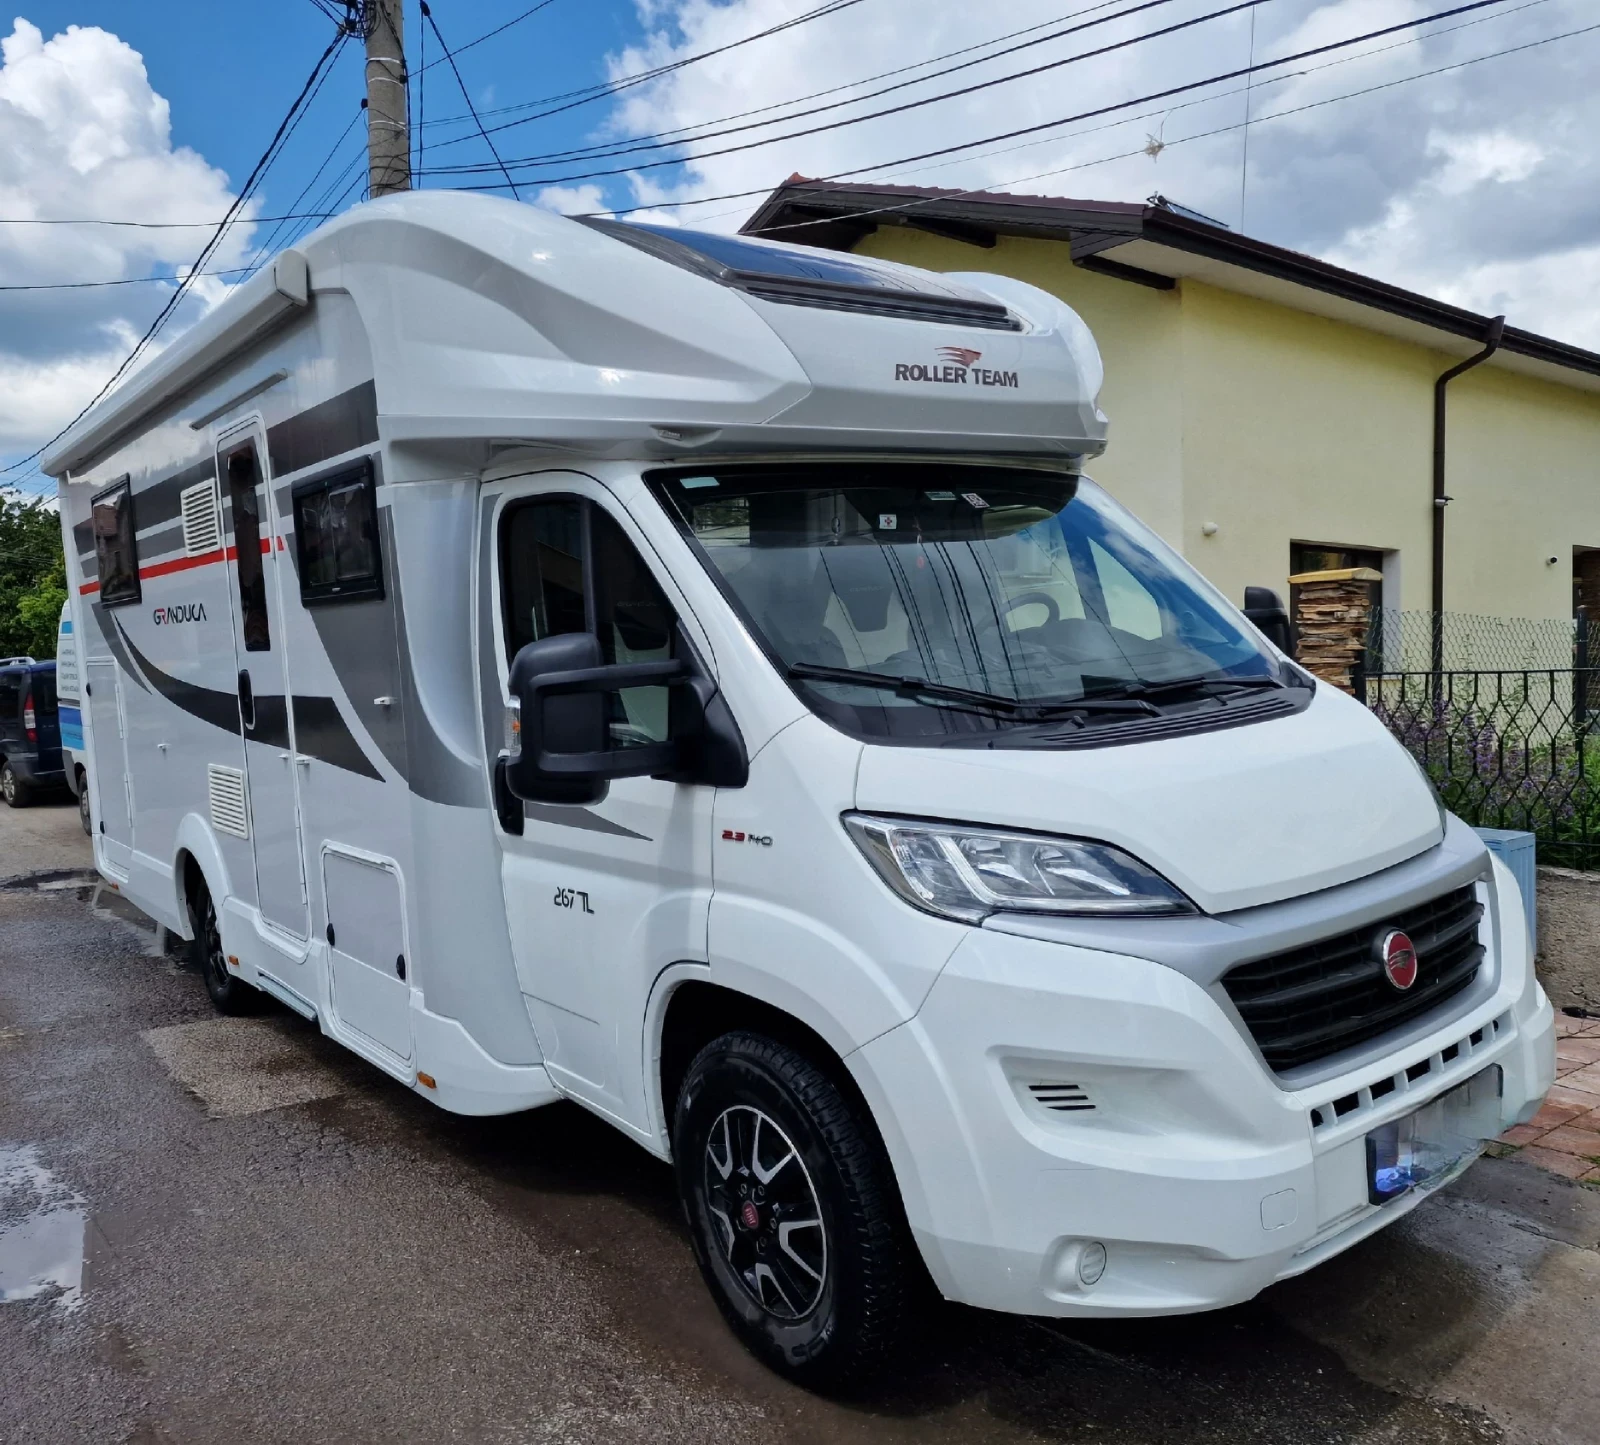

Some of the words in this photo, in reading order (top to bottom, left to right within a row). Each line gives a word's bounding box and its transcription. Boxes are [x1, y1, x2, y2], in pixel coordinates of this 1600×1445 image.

[895, 363, 968, 384] ROLLER
[971, 368, 1019, 388] TEAM
[153, 603, 207, 625] GRANDUCA
[554, 886, 575, 909] 267
[576, 890, 595, 914] TL
